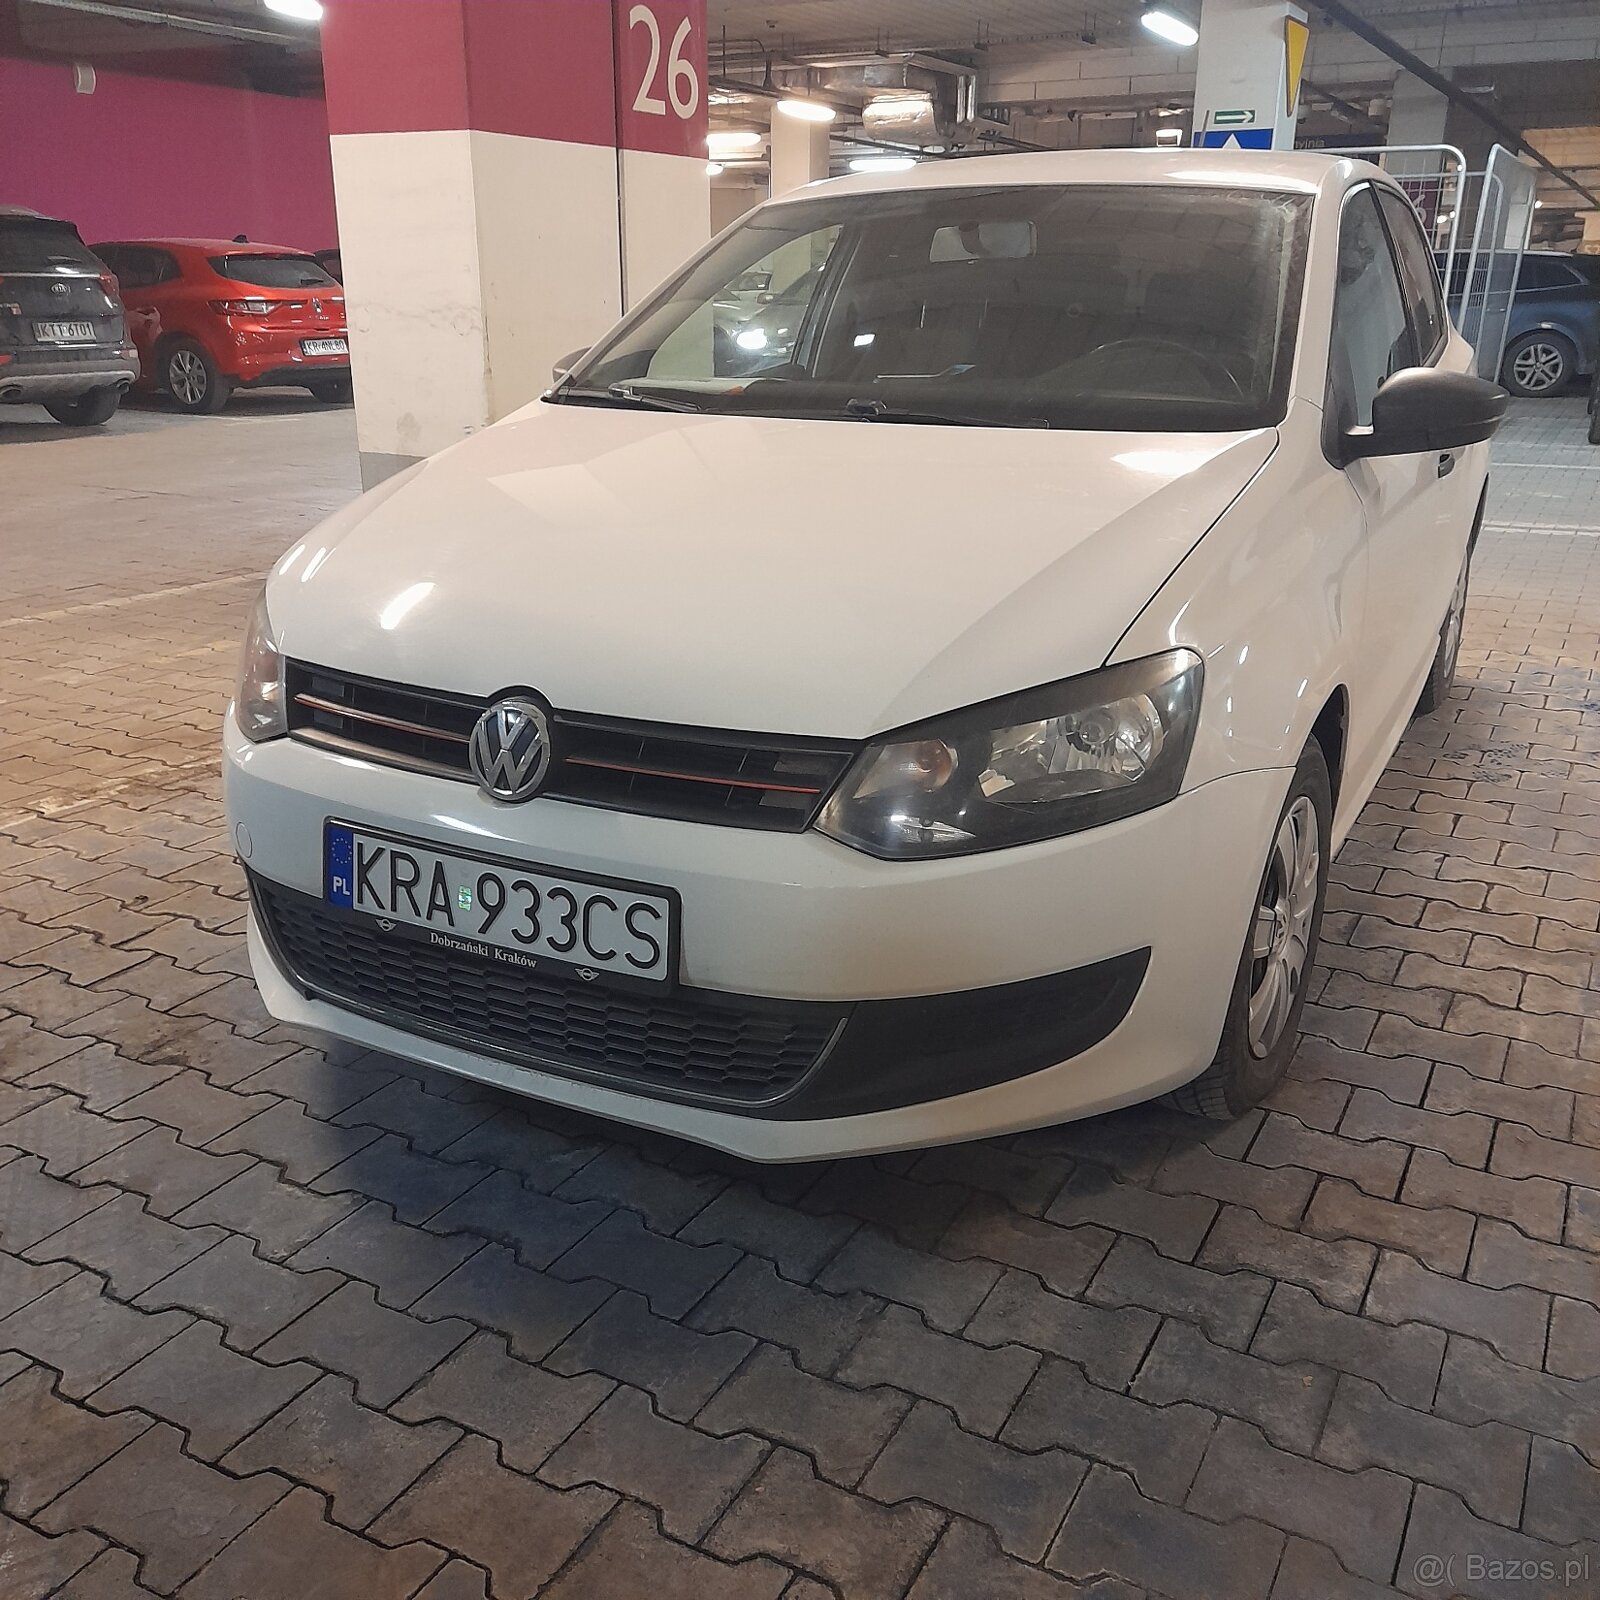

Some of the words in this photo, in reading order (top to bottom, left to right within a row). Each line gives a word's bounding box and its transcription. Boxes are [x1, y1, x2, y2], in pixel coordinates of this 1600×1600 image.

[629, 4, 699, 120] 26
[40, 323, 64, 337] KTT
[332, 876, 351, 897] PL
[356, 842, 456, 928] KRA
[475, 872, 663, 970] 933CS
[429, 932, 489, 957] Dobrzański
[494, 948, 537, 968] Kraków
